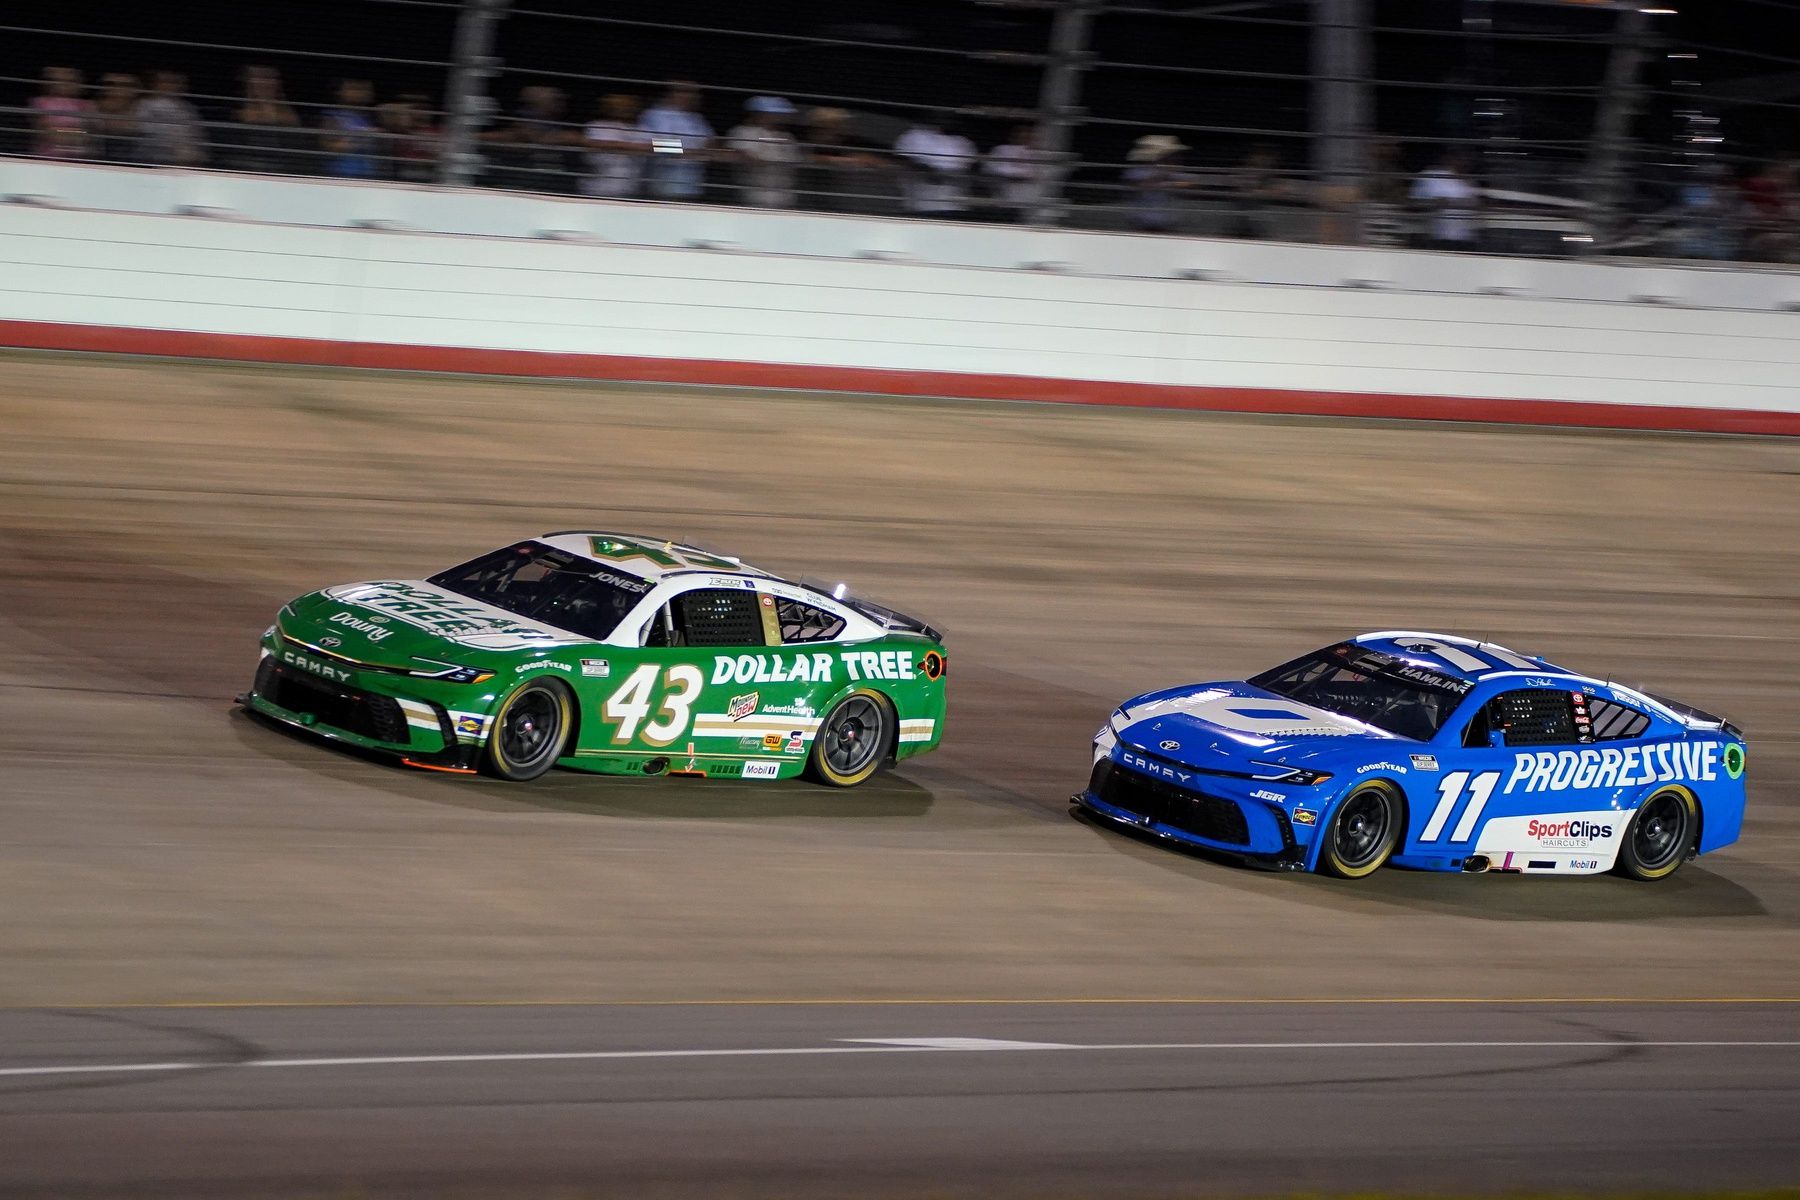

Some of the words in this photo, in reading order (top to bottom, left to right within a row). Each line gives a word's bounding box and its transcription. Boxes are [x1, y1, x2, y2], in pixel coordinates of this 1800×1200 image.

[589, 571, 644, 593] JONES
[329, 611, 394, 641] Downy
[284, 651, 350, 681] CAMRY
[515, 660, 572, 673] GOODYEAR
[711, 654, 833, 685] DOLLAR
[840, 651, 914, 681] TREE
[1400, 666, 1464, 693] HAMLIN
[603, 664, 703, 746] 43
[762, 704, 815, 715] AdventHealth
[746, 765, 767, 774] Mobil
[1123, 752, 1192, 783] CAMRY
[1356, 761, 1407, 774] GOODYEAR
[1502, 741, 1718, 795] PROGRESSIVE
[1249, 790, 1286, 804] JGR
[1419, 771, 1500, 842] 11
[1527, 819, 1612, 841] SportClips
[1542, 839, 1587, 847] HAIRCUTS
[1569, 859, 1590, 869] Mobil
